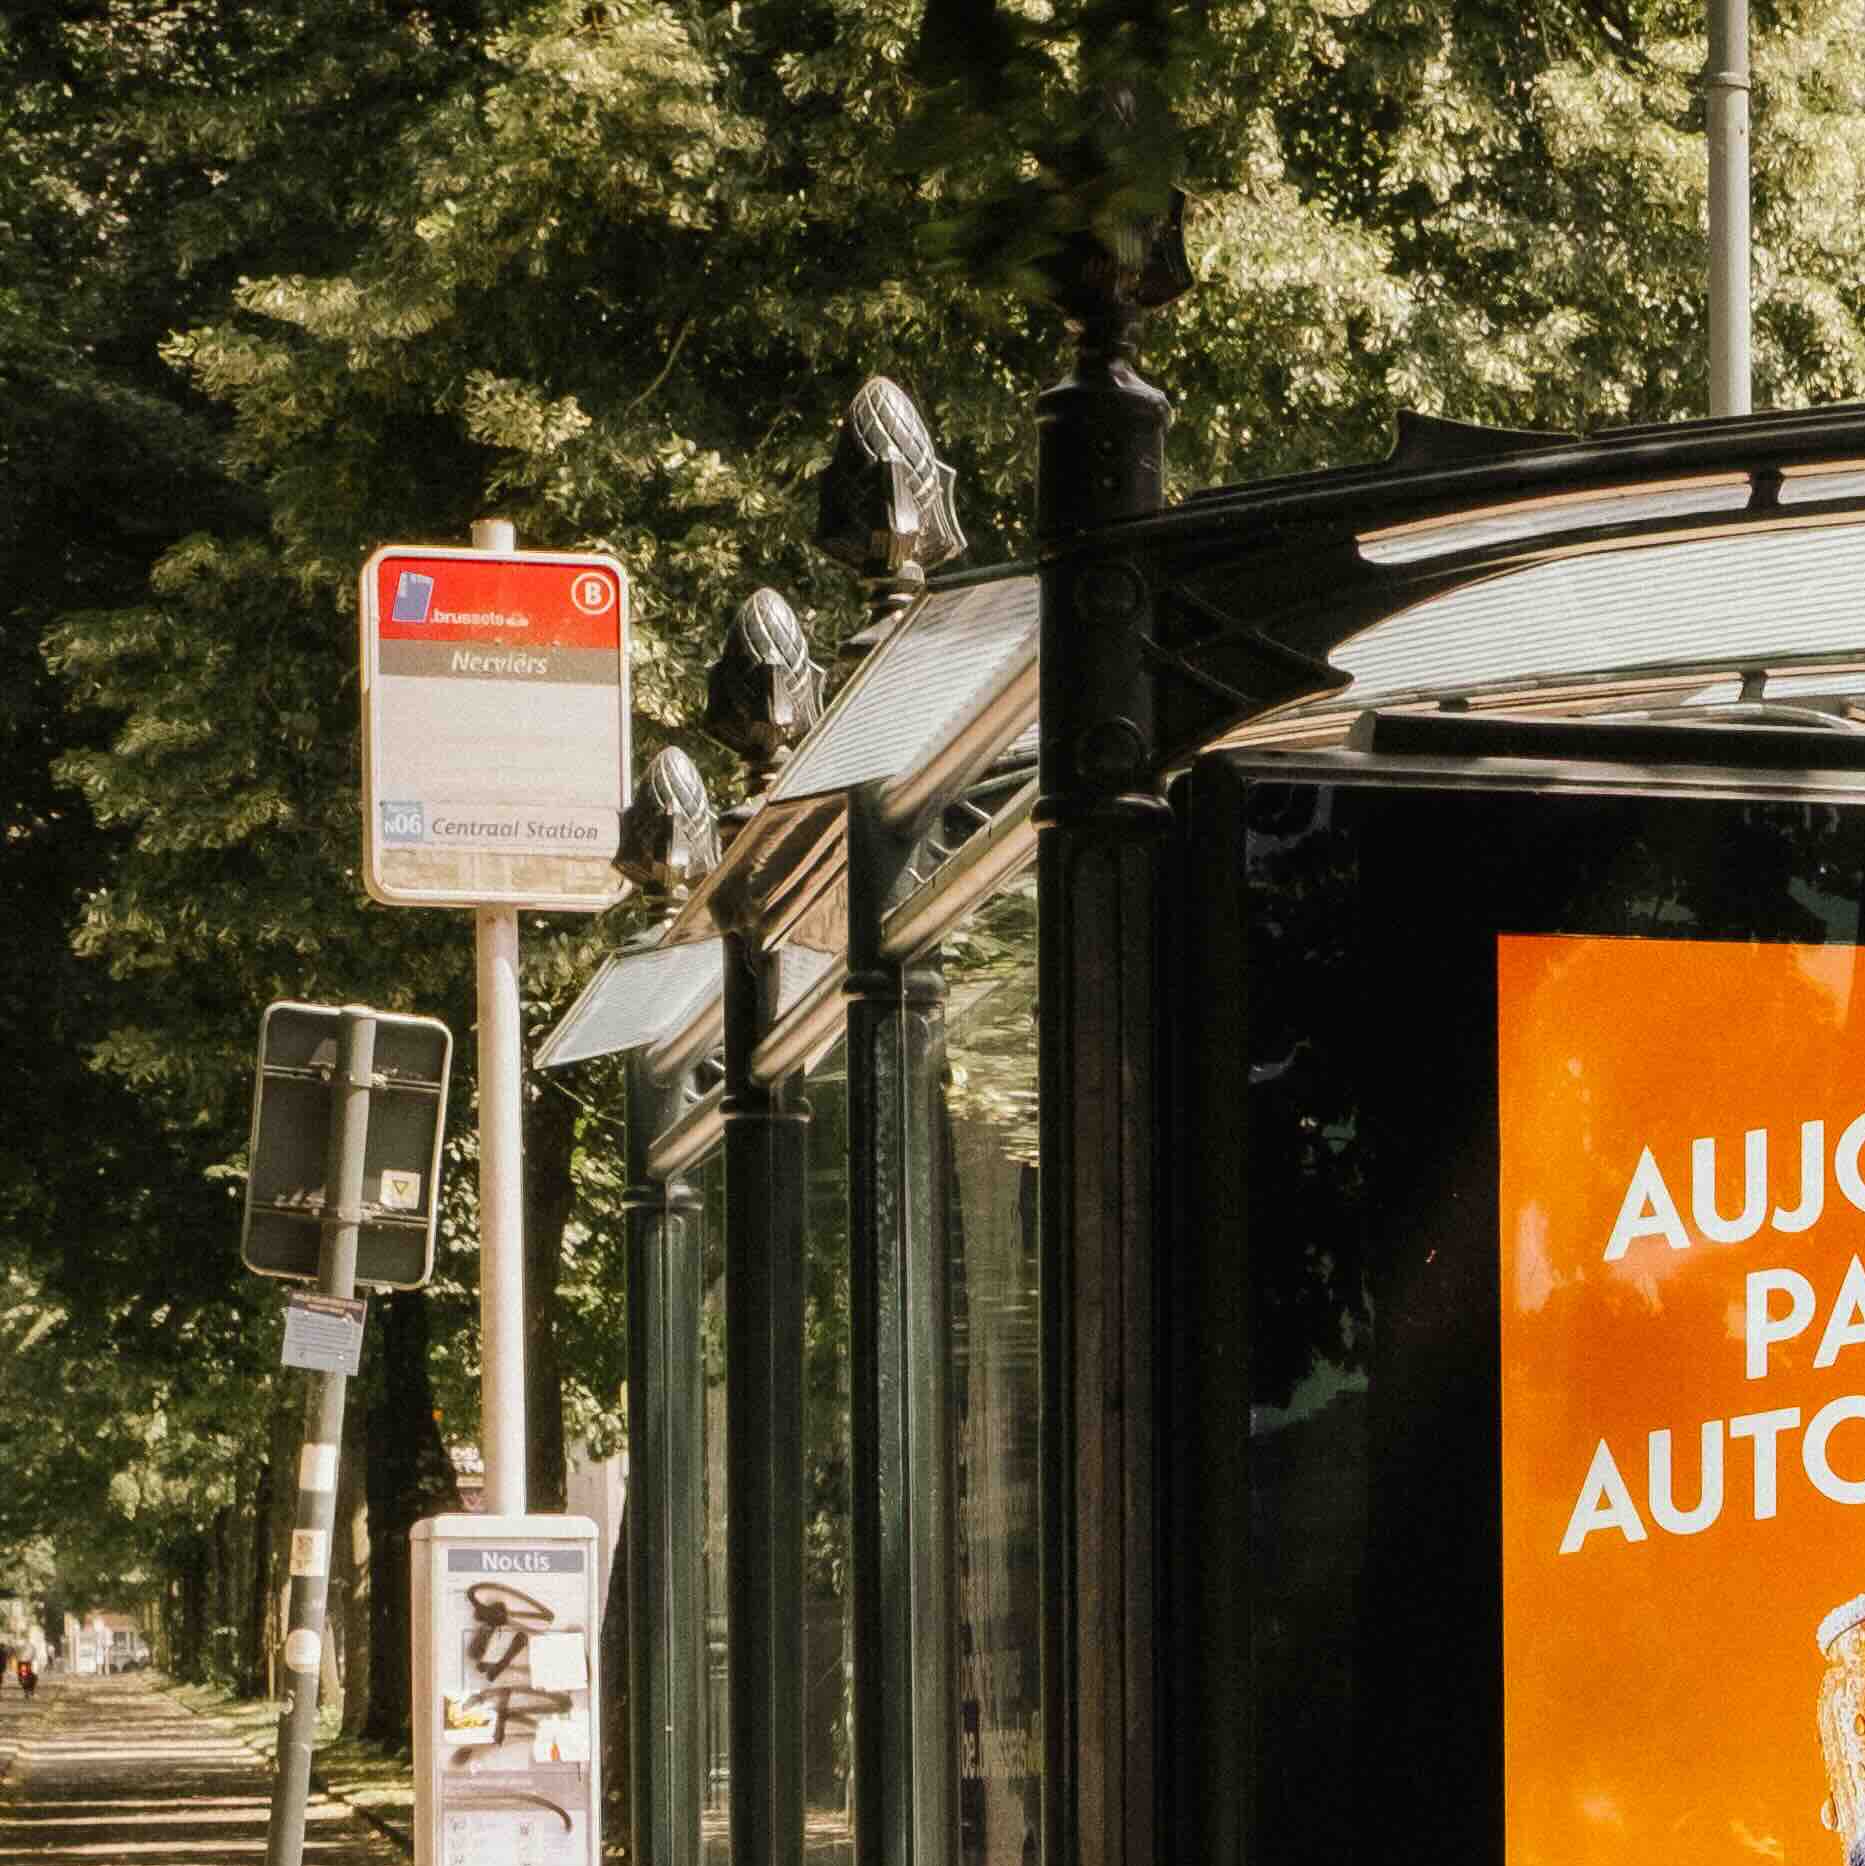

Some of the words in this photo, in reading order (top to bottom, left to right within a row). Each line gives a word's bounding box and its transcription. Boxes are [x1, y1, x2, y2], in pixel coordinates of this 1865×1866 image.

[584, 581, 603, 606] B
[432, 818, 520, 839] Centraal
[526, 821, 599, 842] Station
